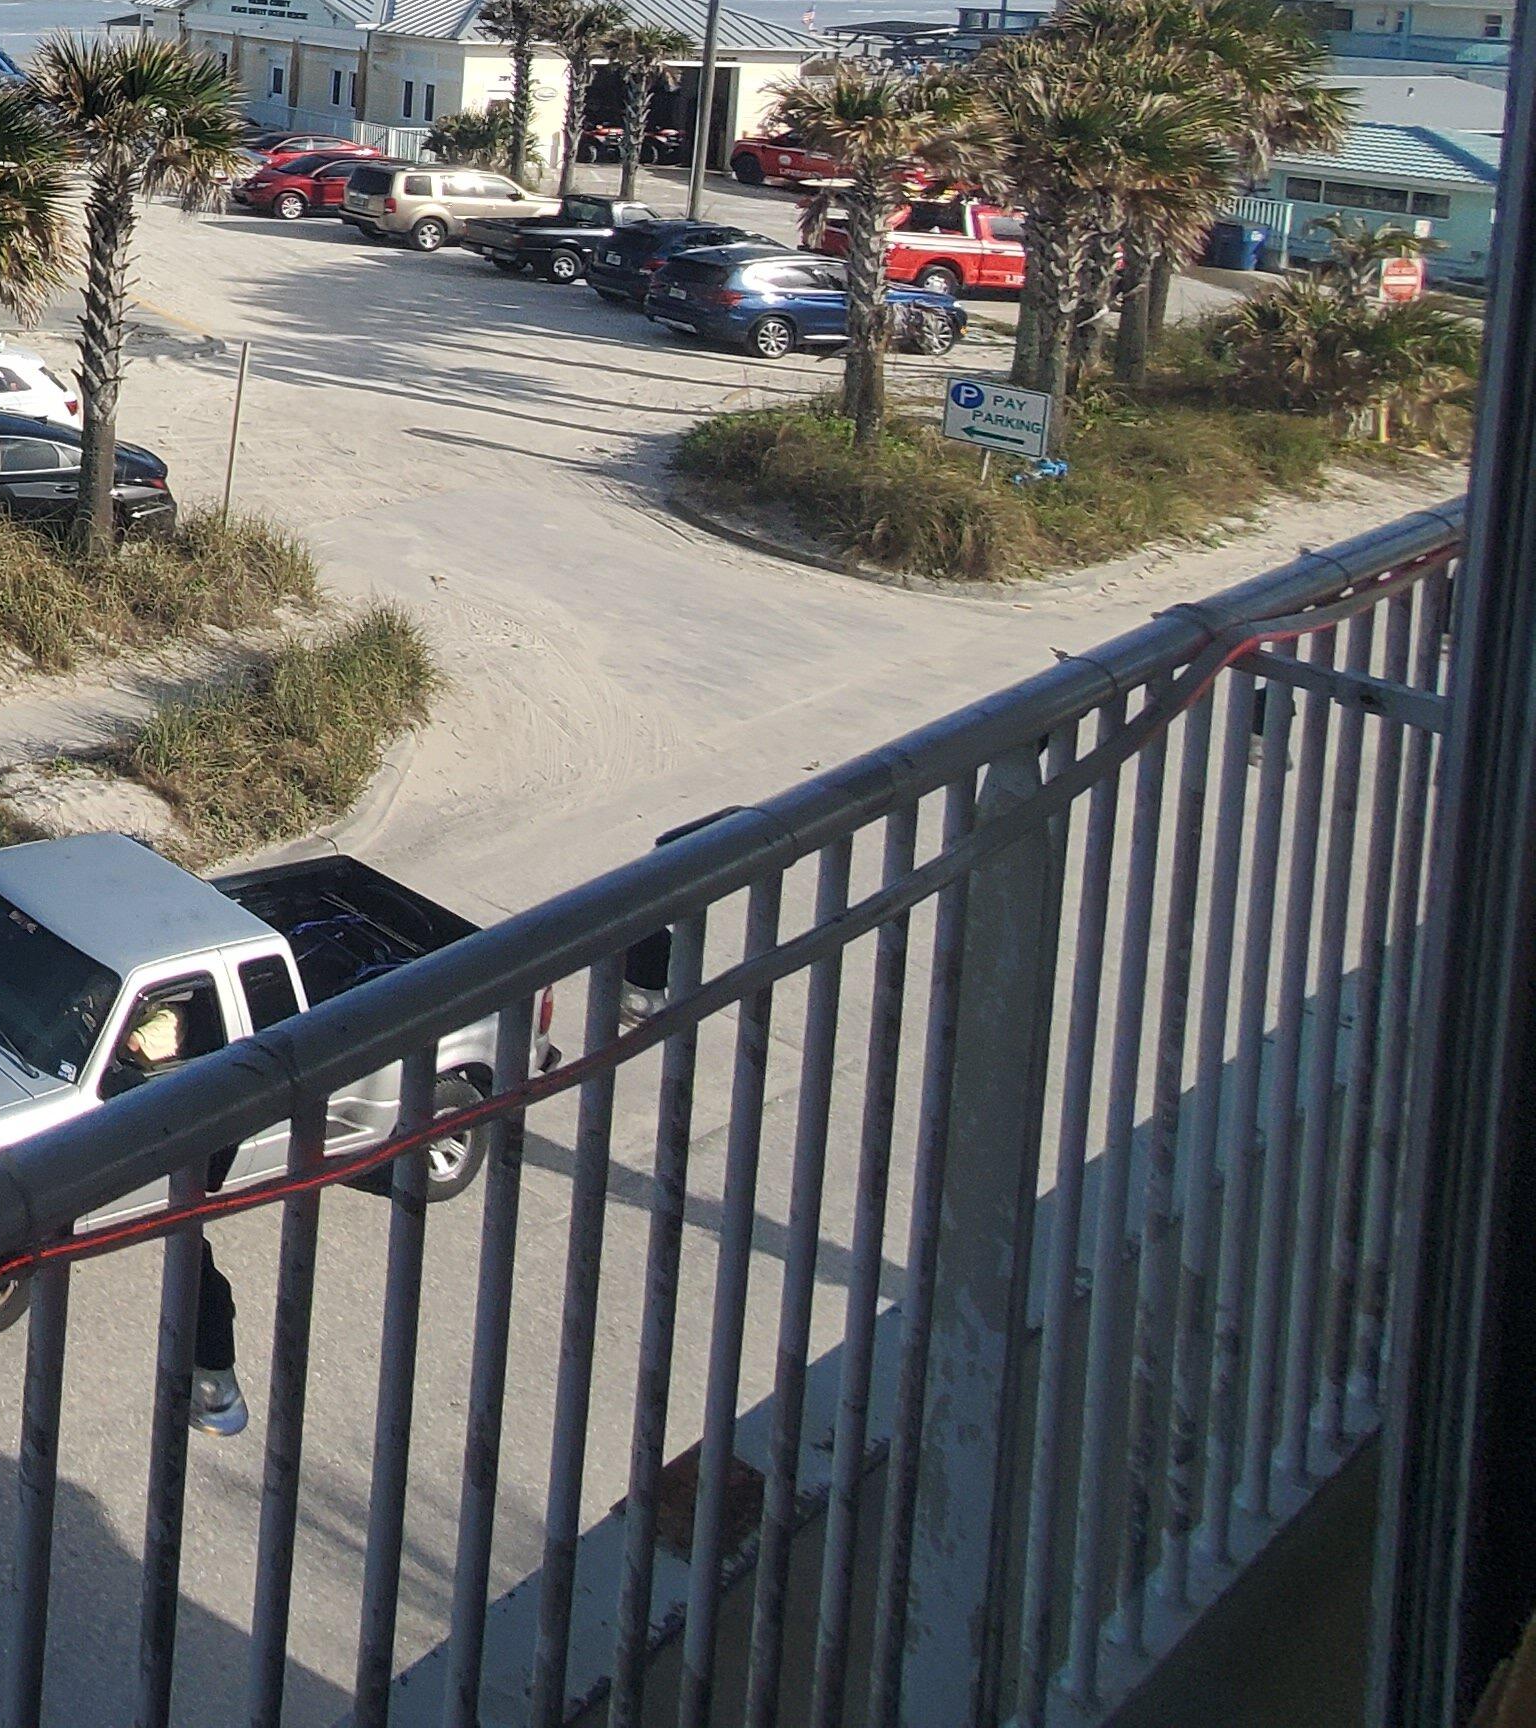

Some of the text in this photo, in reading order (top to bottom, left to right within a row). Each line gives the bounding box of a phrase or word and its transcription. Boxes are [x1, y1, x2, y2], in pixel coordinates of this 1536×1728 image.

[960, 385, 978, 404] P
[992, 395, 1027, 411] PAY
[972, 410, 1042, 434] PARKING
